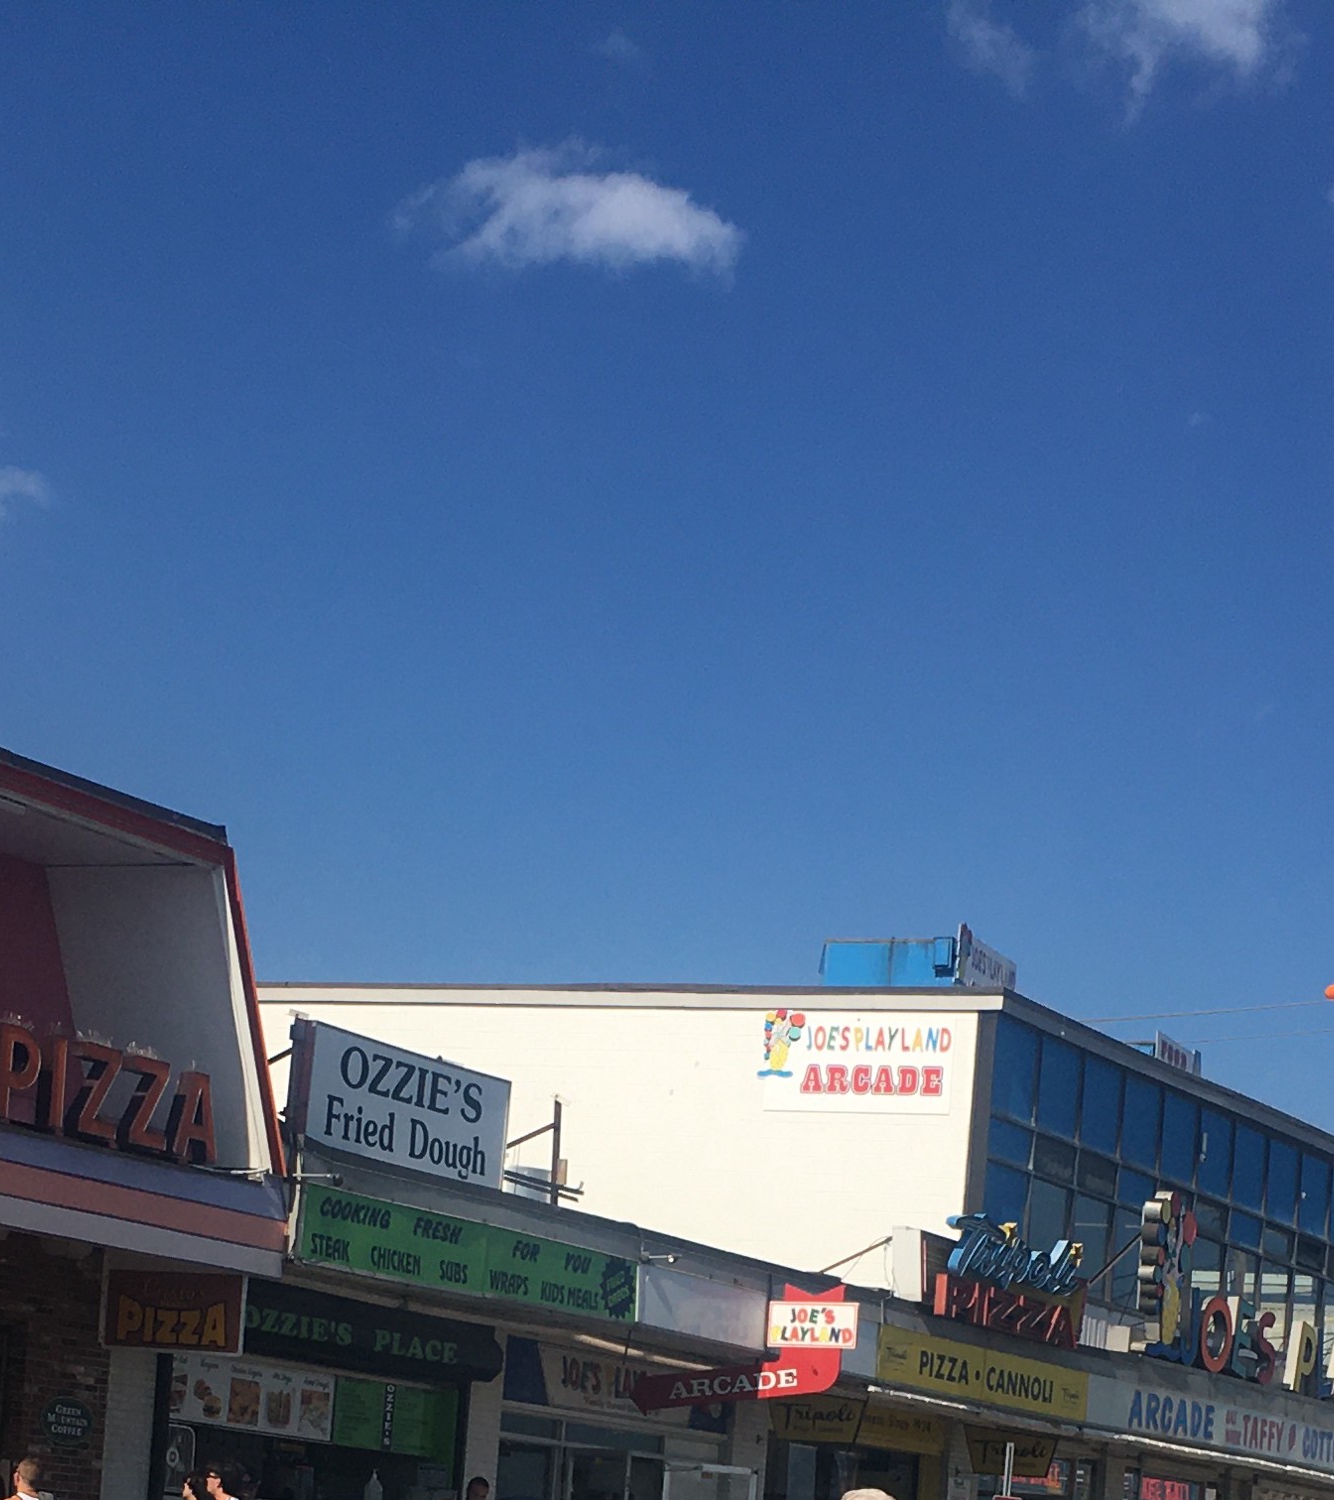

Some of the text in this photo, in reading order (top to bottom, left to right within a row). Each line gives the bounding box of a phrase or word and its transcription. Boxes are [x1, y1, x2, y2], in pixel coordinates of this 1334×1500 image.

[853, 1025, 952, 1053] PLAYLAND
[340, 1045, 483, 1123] OZZIE'S
[799, 1064, 944, 1097] ARCADE
[323, 1094, 486, 1180] Fried Dough
[319, 1196, 593, 1276] COOKING FRESH FOR YOU
[945, 1212, 1084, 1297] Tripoli
[310, 1232, 350, 1263] STEAK
[370, 1245, 422, 1277] CHICKEN
[438, 1258, 468, 1285] SUBS
[488, 1268, 530, 1297] WRAPS
[539, 1280, 565, 1305] KIDS
[567, 1286, 602, 1310] MEALS
[116, 1294, 226, 1347] PIZZA
[245, 1303, 459, 1365] OZZIE'S PLACE
[770, 1325, 854, 1344] PLAYLAND
[789, 1307, 836, 1326] JOE'S
[932, 1273, 1078, 1349] PIZZA
[668, 1367, 798, 1401] ARCADE
[918, 1349, 1055, 1404] PIZZA CANNOLI
[46, 1412, 89, 1428] MUNTAIN
[774, 1401, 857, 1432] Tripoli
[1127, 1389, 1216, 1440] ARCADE
[1242, 1413, 1285, 1453] TAFFY
